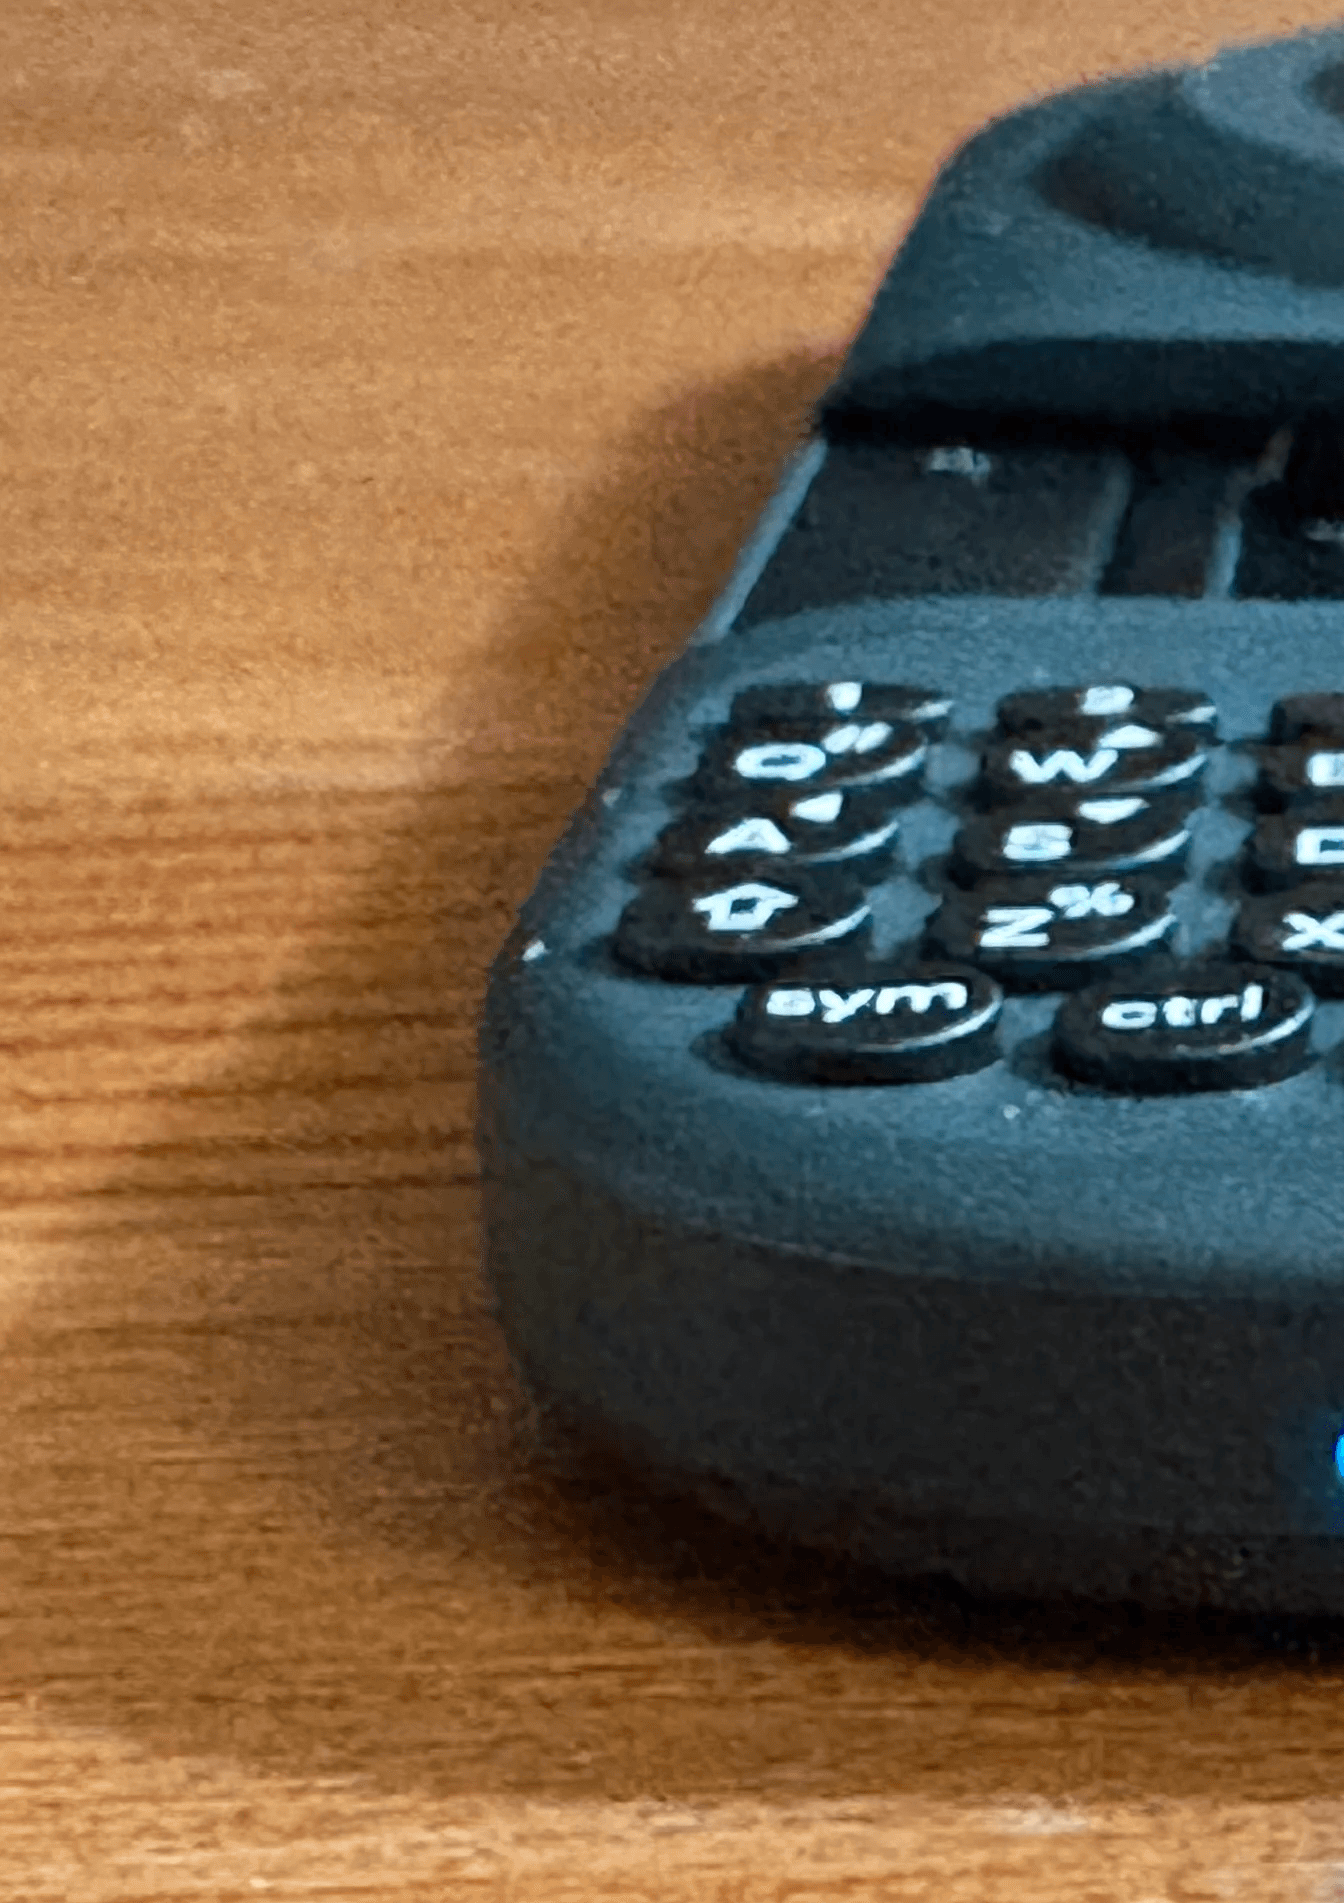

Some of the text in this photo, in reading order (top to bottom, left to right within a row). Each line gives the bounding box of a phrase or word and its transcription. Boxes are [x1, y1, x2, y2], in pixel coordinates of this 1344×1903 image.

[1008, 748, 1119, 784] W
[704, 817, 792, 855] A
[977, 906, 1055, 949] Z
[765, 981, 969, 1024] sym
[1100, 983, 1265, 1030] ctrl
